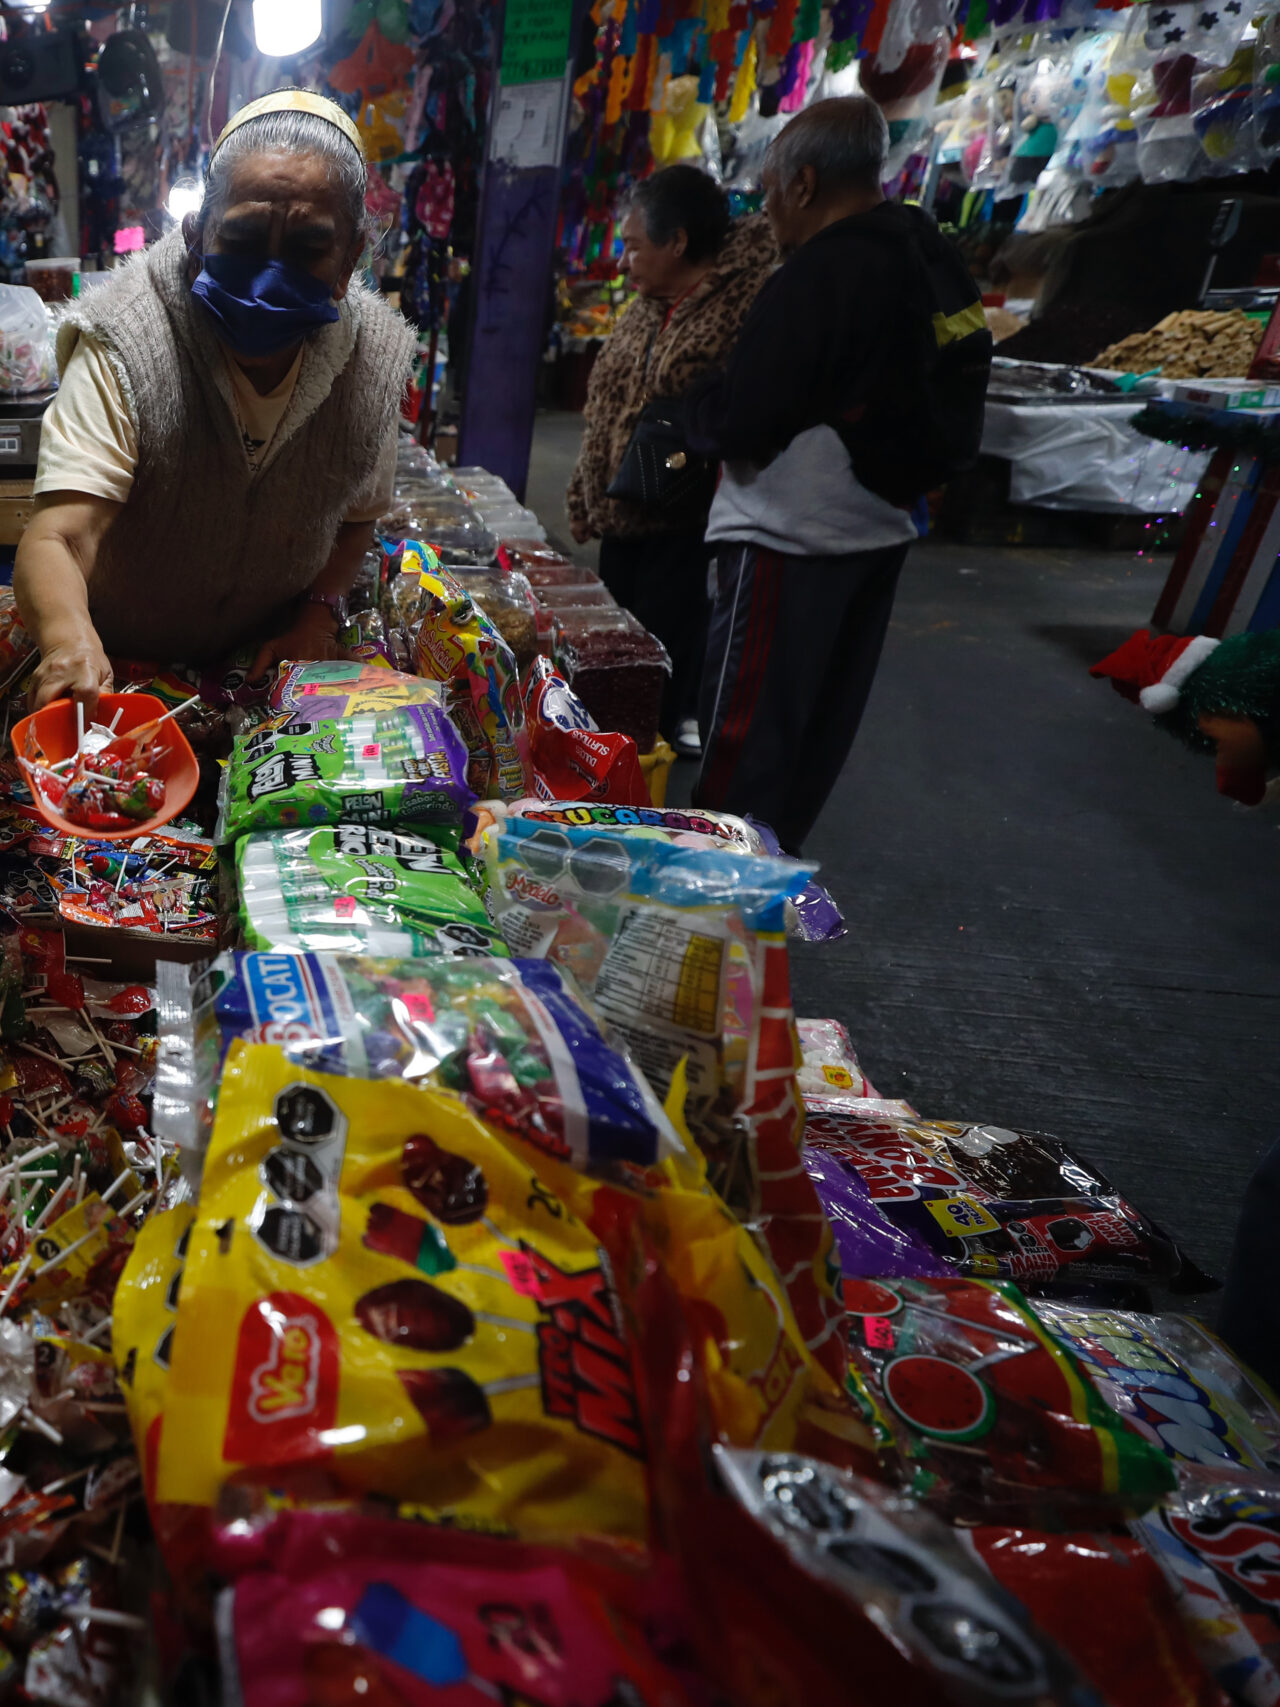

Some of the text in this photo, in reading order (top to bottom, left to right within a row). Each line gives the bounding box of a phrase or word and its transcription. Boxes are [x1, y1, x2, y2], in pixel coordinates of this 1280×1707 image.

[571, 730, 610, 756] SURTIDOS
[345, 793, 383, 812] PELON
[406, 793, 436, 807] sabor
[947, 1204, 972, 1228] 40
[958, 1200, 987, 1226] PIEZAS
[1009, 1253, 1058, 1276] MALVA
[254, 1320, 316, 1418] Vero
